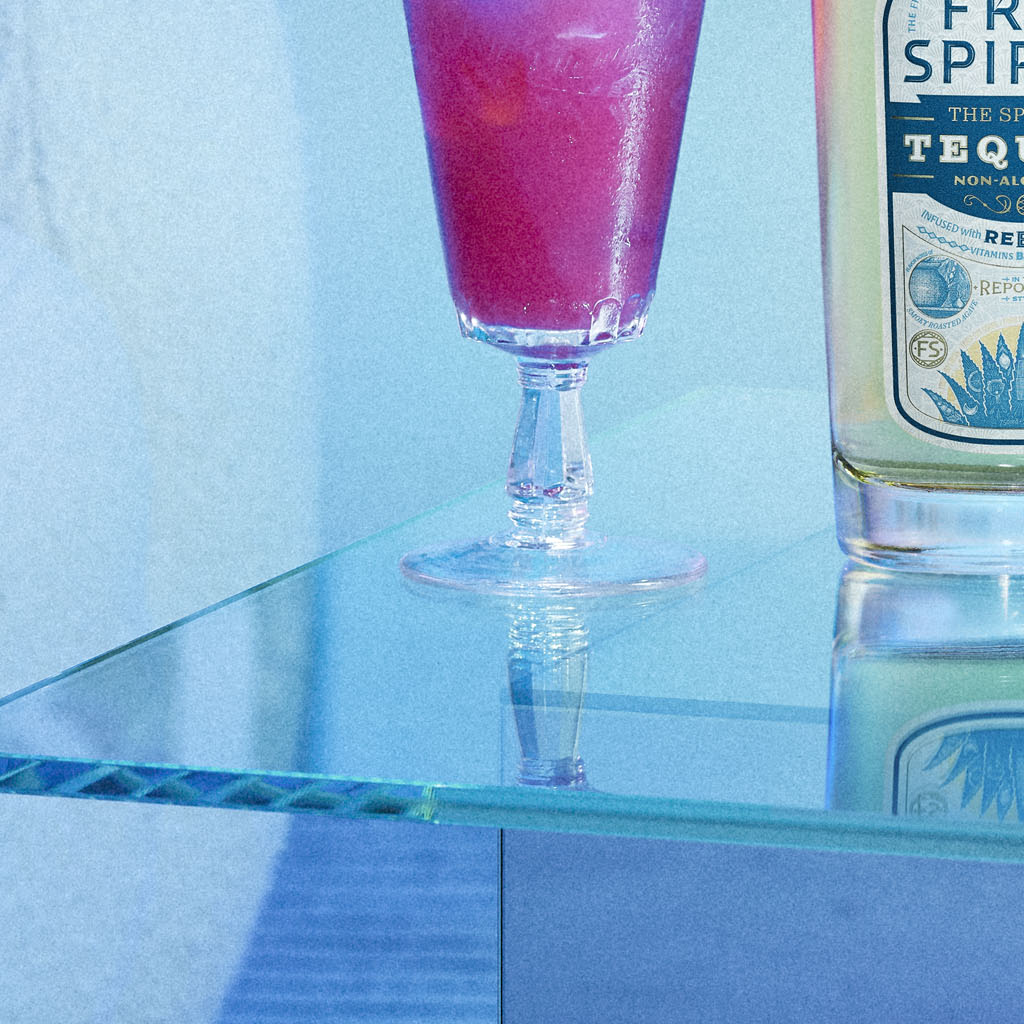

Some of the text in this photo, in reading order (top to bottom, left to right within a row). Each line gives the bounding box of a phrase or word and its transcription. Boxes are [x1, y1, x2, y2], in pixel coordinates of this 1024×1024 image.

[907, 12, 917, 33] THE
[948, 106, 992, 122] THE
[921, 209, 960, 233] INFUSED
[960, 227, 982, 239] with
[970, 247, 1014, 260] VITAMINS
[917, 340, 940, 357] FS
